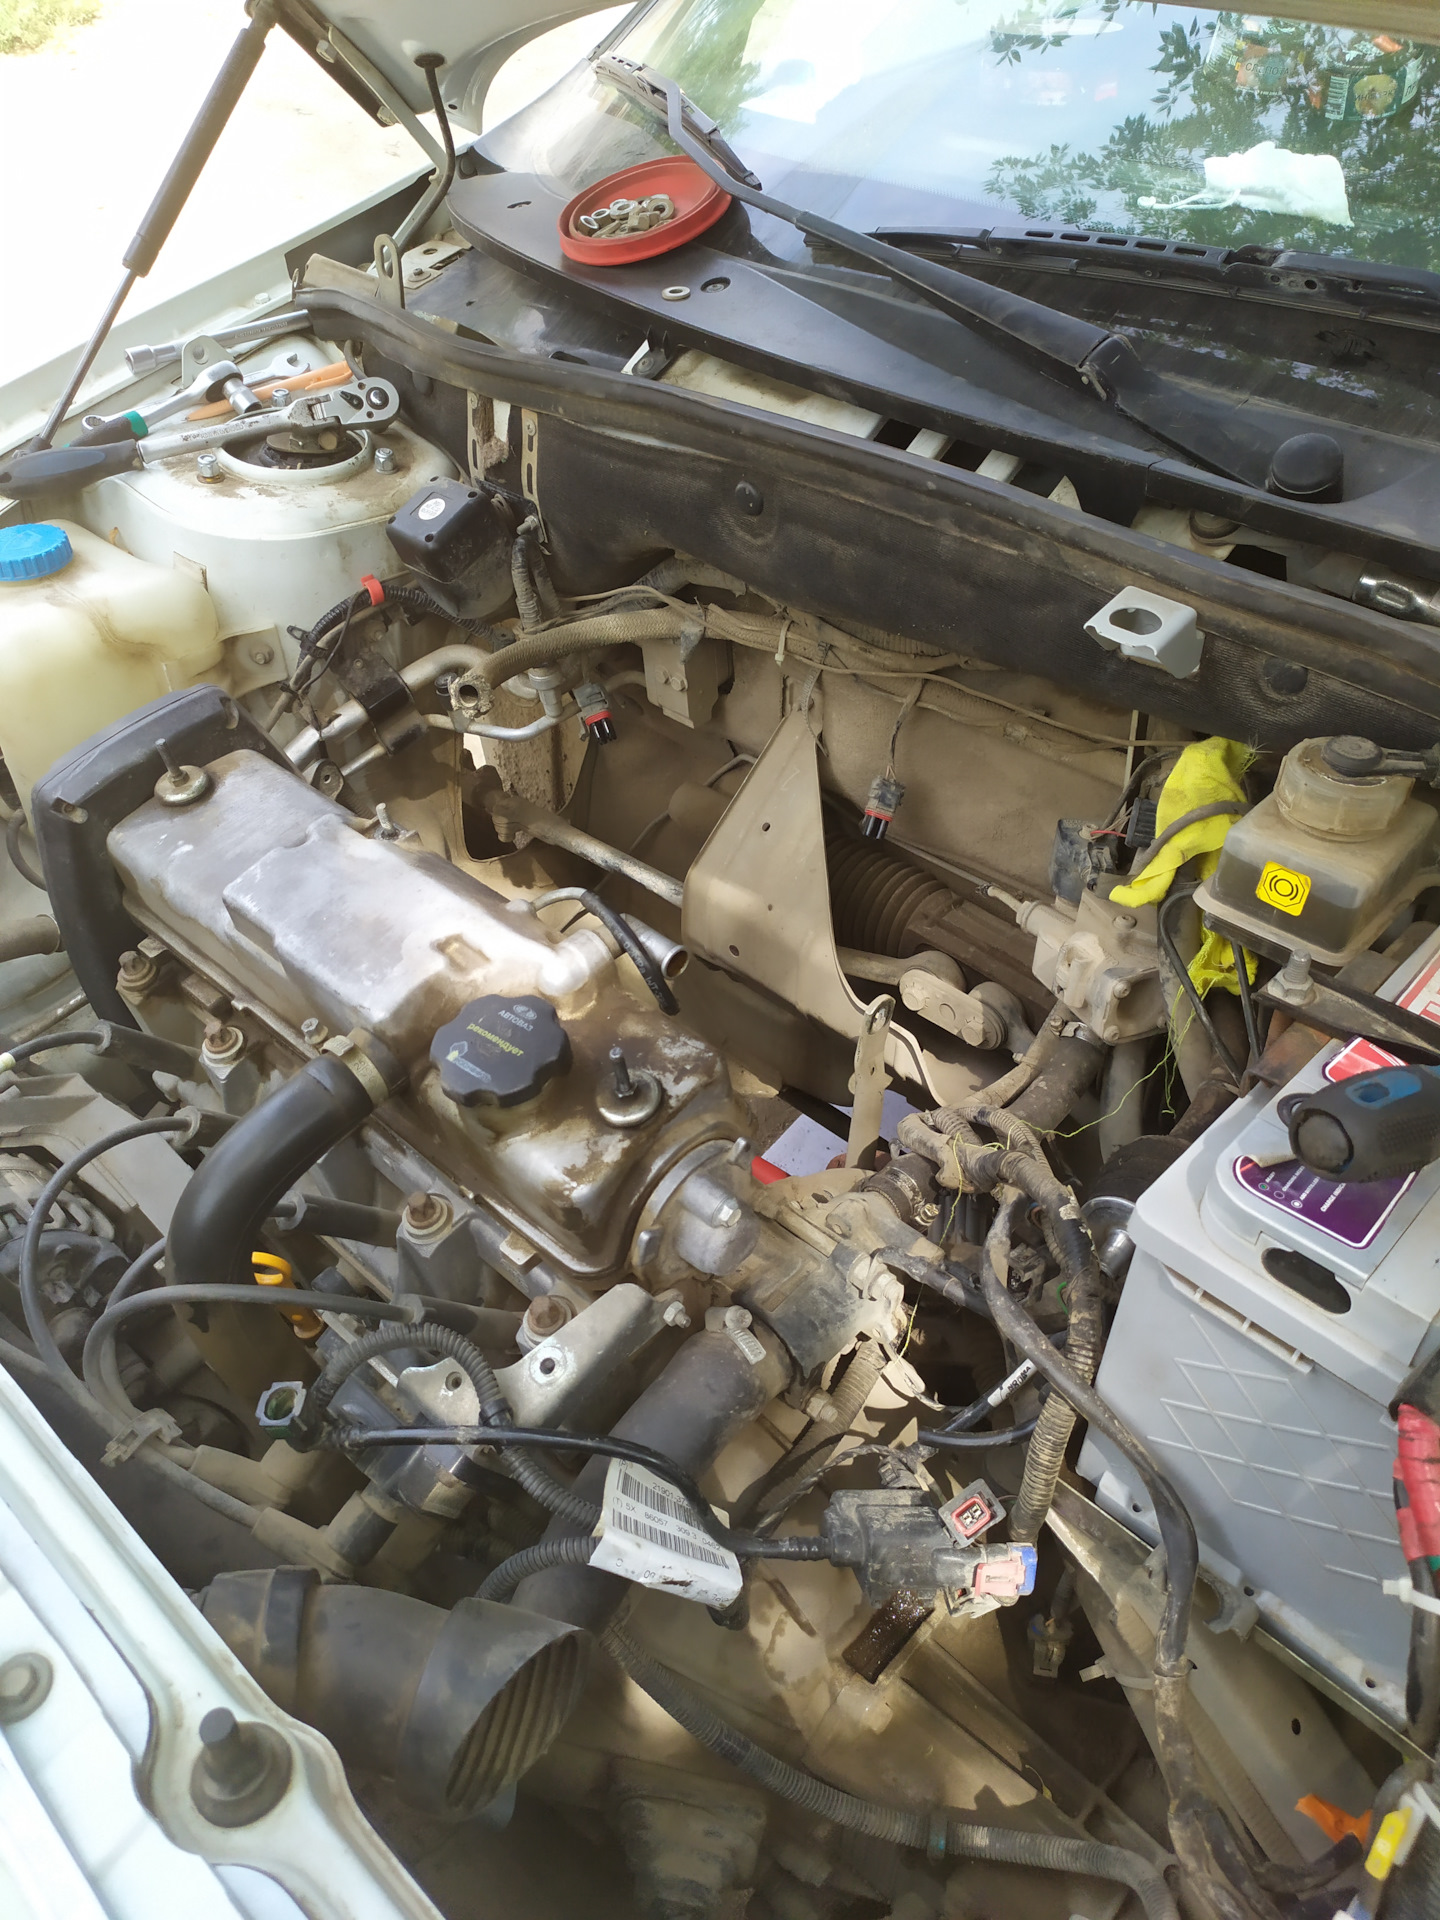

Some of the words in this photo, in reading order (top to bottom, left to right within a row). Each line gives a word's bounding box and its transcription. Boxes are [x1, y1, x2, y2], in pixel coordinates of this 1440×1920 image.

[498, 1010, 534, 1031] АВТОВАЗ
[466, 1022, 525, 1057] рекомендует
[652, 1482, 692, 1509] 21901-37
